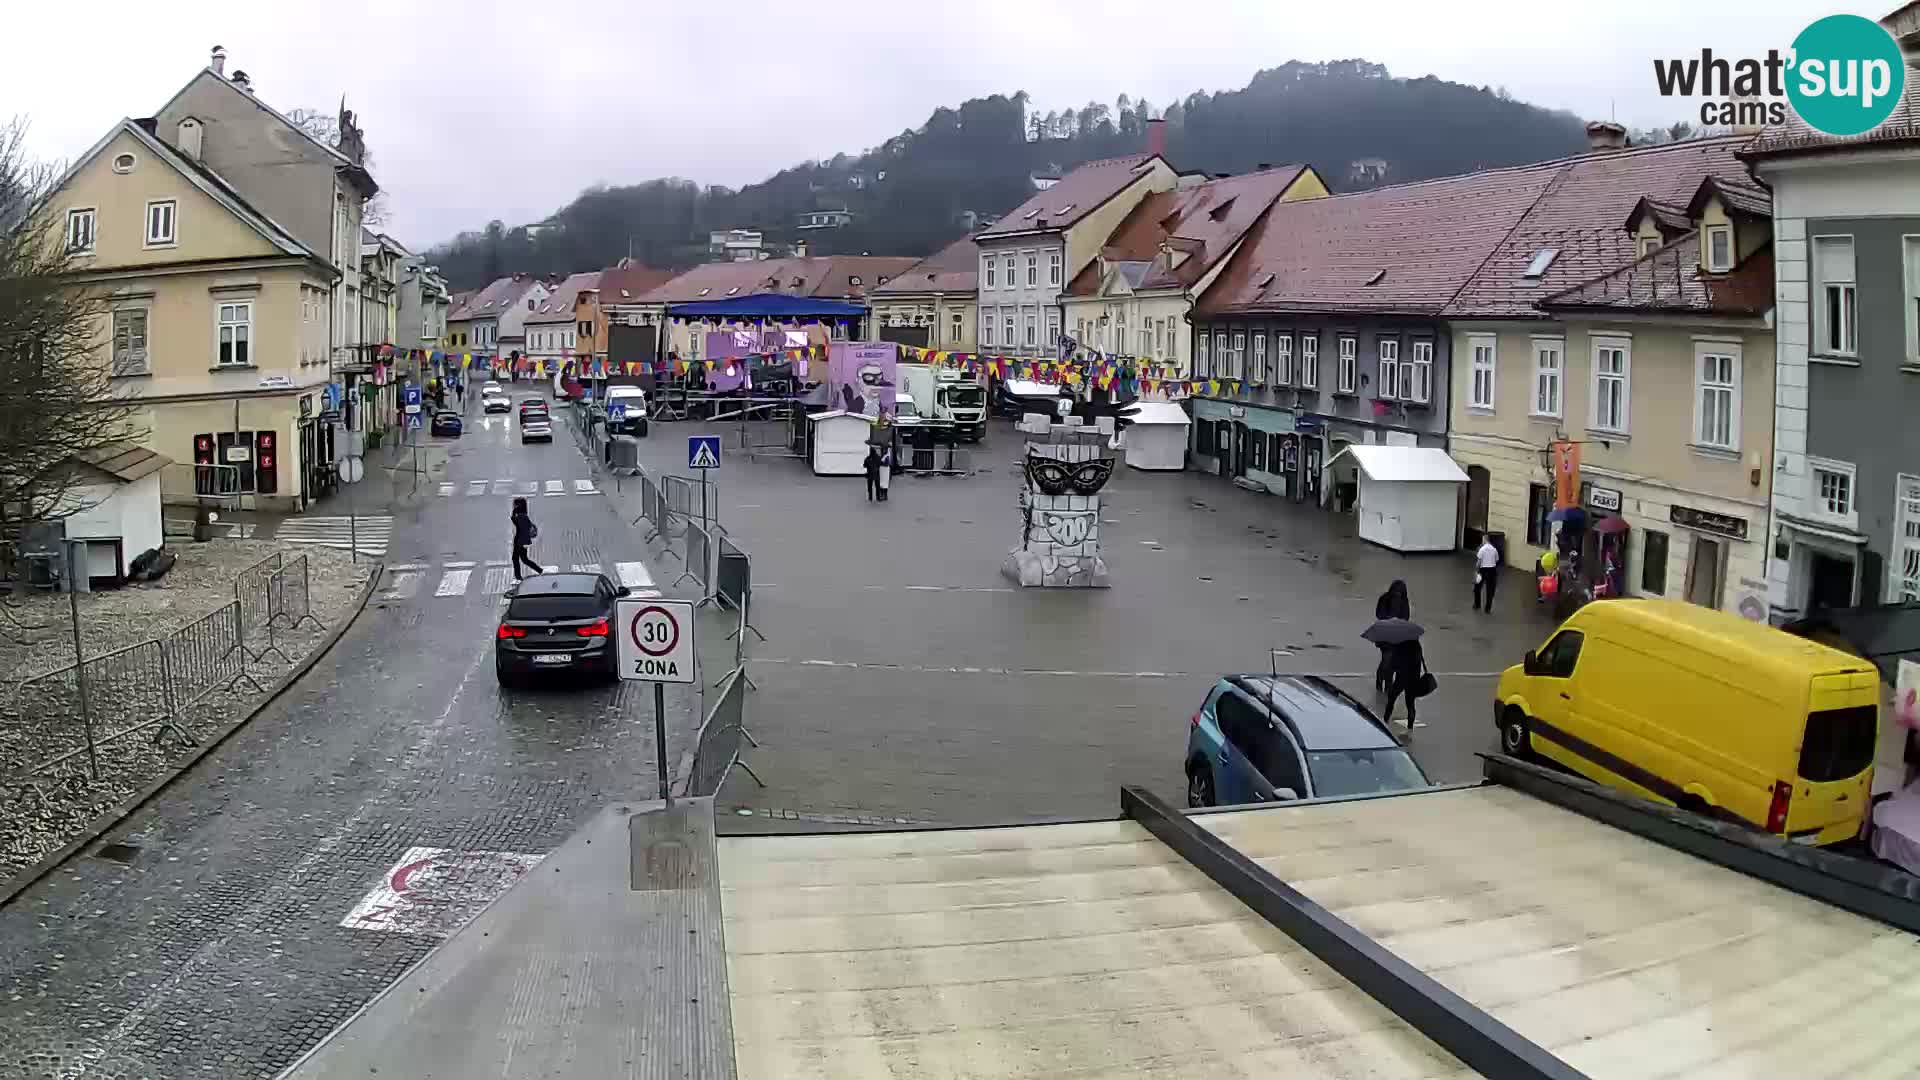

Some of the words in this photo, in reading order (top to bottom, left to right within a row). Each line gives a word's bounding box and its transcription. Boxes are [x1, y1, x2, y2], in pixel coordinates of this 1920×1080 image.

[409, 391, 417, 402] P
[1048, 516, 1088, 546] 200
[643, 622, 668, 643] 30
[634, 660, 678, 676] ZONA
